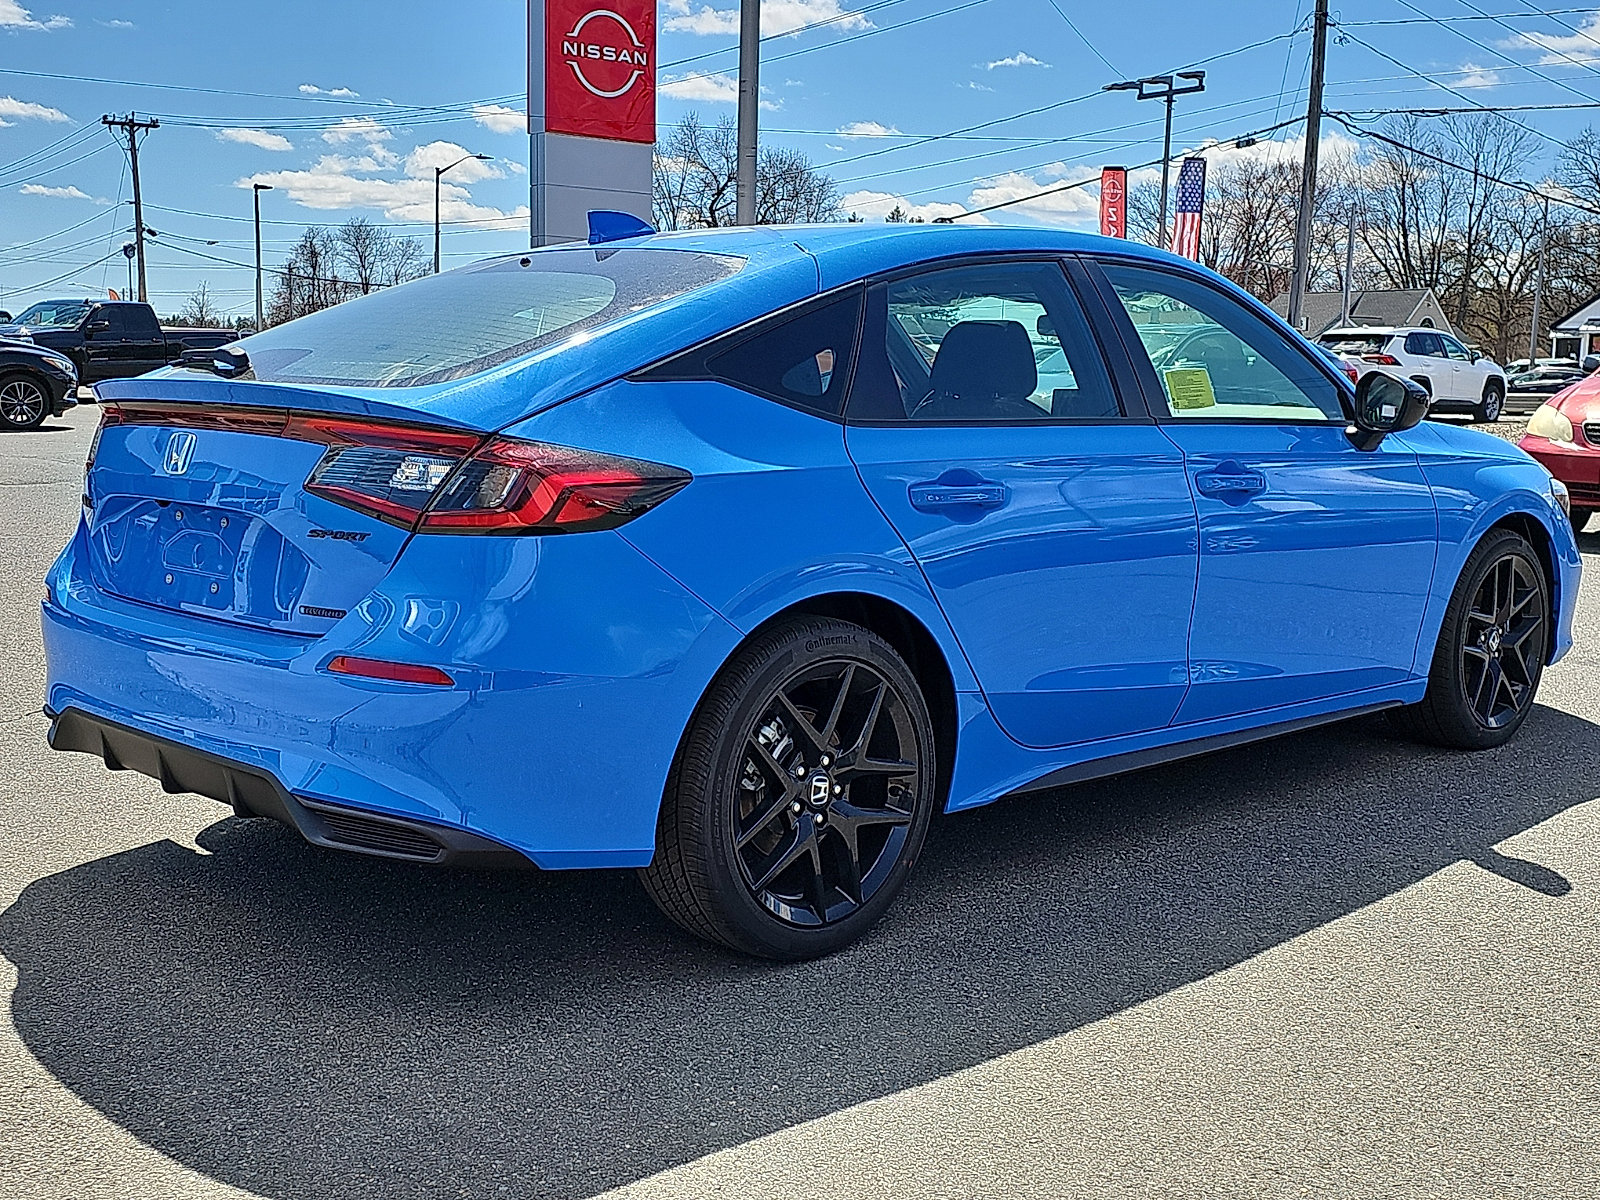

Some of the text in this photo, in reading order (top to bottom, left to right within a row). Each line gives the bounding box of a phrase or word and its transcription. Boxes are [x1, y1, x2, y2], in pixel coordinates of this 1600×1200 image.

[563, 41, 647, 66] NISSAN
[307, 529, 371, 541] SPORT
[805, 634, 851, 652] Continental
